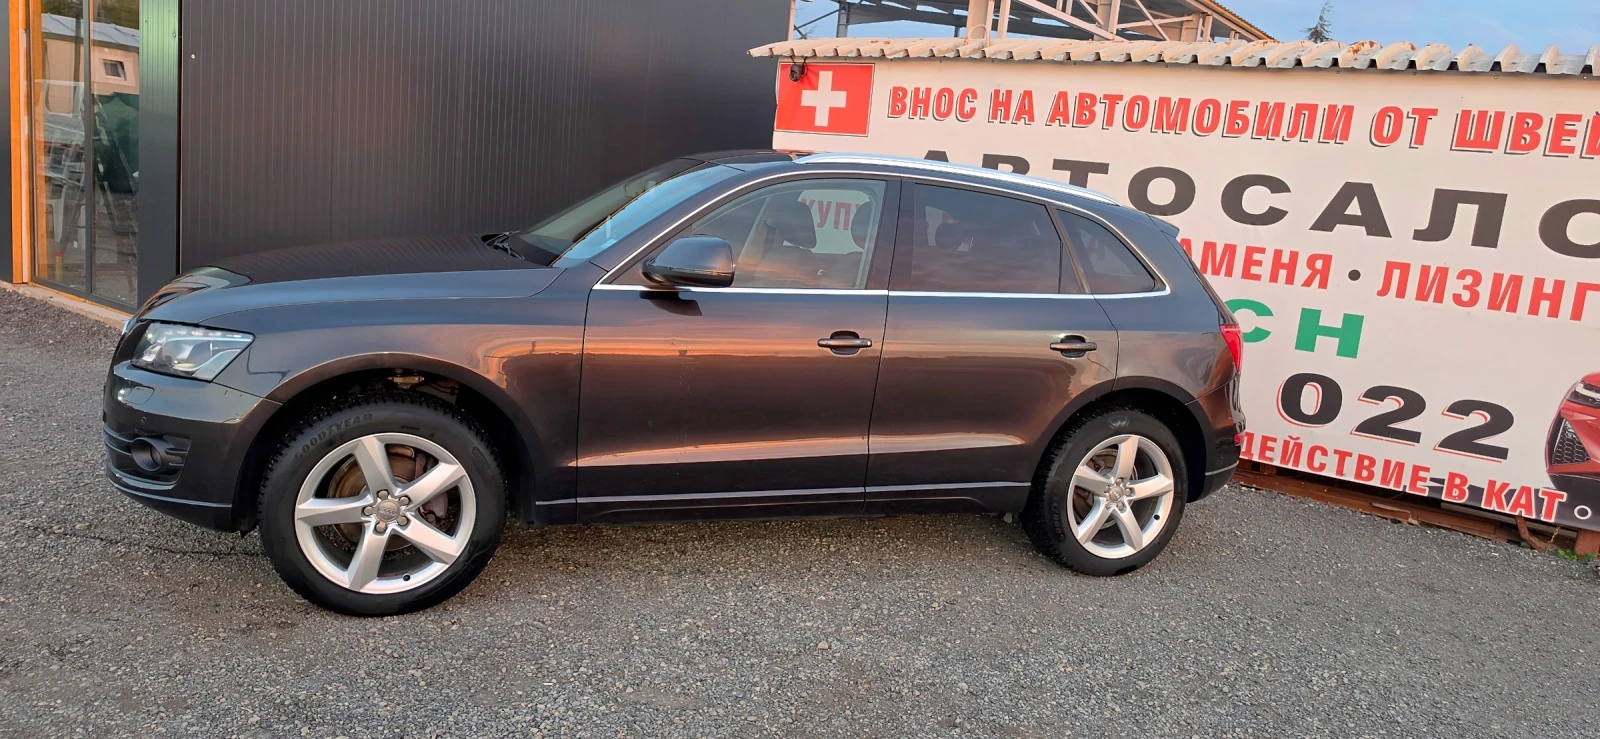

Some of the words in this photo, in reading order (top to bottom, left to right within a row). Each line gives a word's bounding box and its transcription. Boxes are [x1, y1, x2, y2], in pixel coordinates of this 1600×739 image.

[886, 86, 978, 122] ВНОС
[988, 89, 1036, 125] НА
[1046, 91, 1355, 145] АВТОМОБИЛИ
[1369, 106, 1439, 149] ОТ
[1377, 261, 1600, 321] ЛИЗИНГ
[1276, 371, 1515, 463] 022
[1443, 471, 1469, 502] В
[1483, 478, 1567, 523] КАТ
